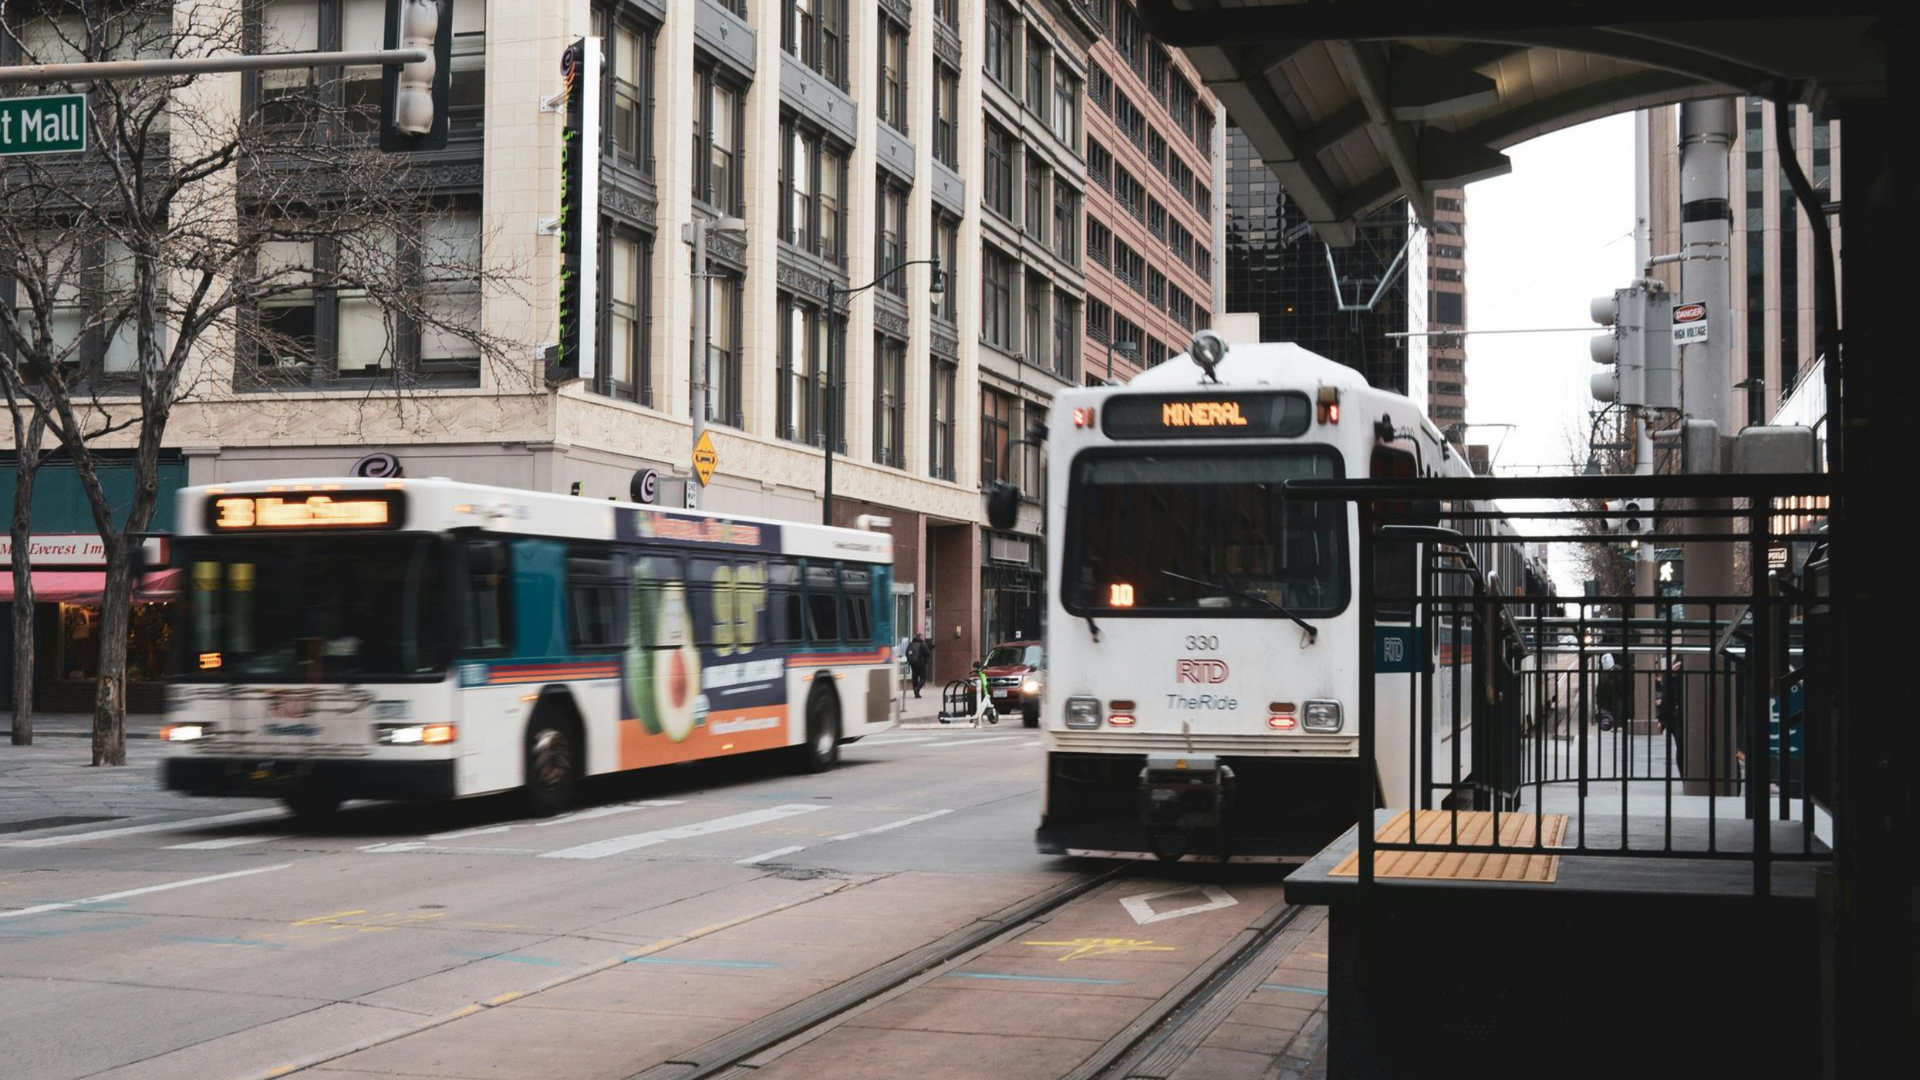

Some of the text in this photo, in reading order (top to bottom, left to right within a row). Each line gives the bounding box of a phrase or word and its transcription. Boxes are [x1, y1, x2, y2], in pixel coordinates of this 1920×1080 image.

[21, 104, 79, 143] Mall
[1676, 307, 1703, 320] DANGER
[1674, 326, 1706, 339] HIGH VOLTAGE
[1163, 402, 1248, 426] MINERAL
[29, 542, 76, 555] Everest
[1768, 552, 1786, 560] POTLE
[1185, 635, 1219, 651] 330
[1383, 637, 1404, 662] RTD
[1176, 659, 1229, 684] RTD
[1166, 693, 1238, 710] TheRide
